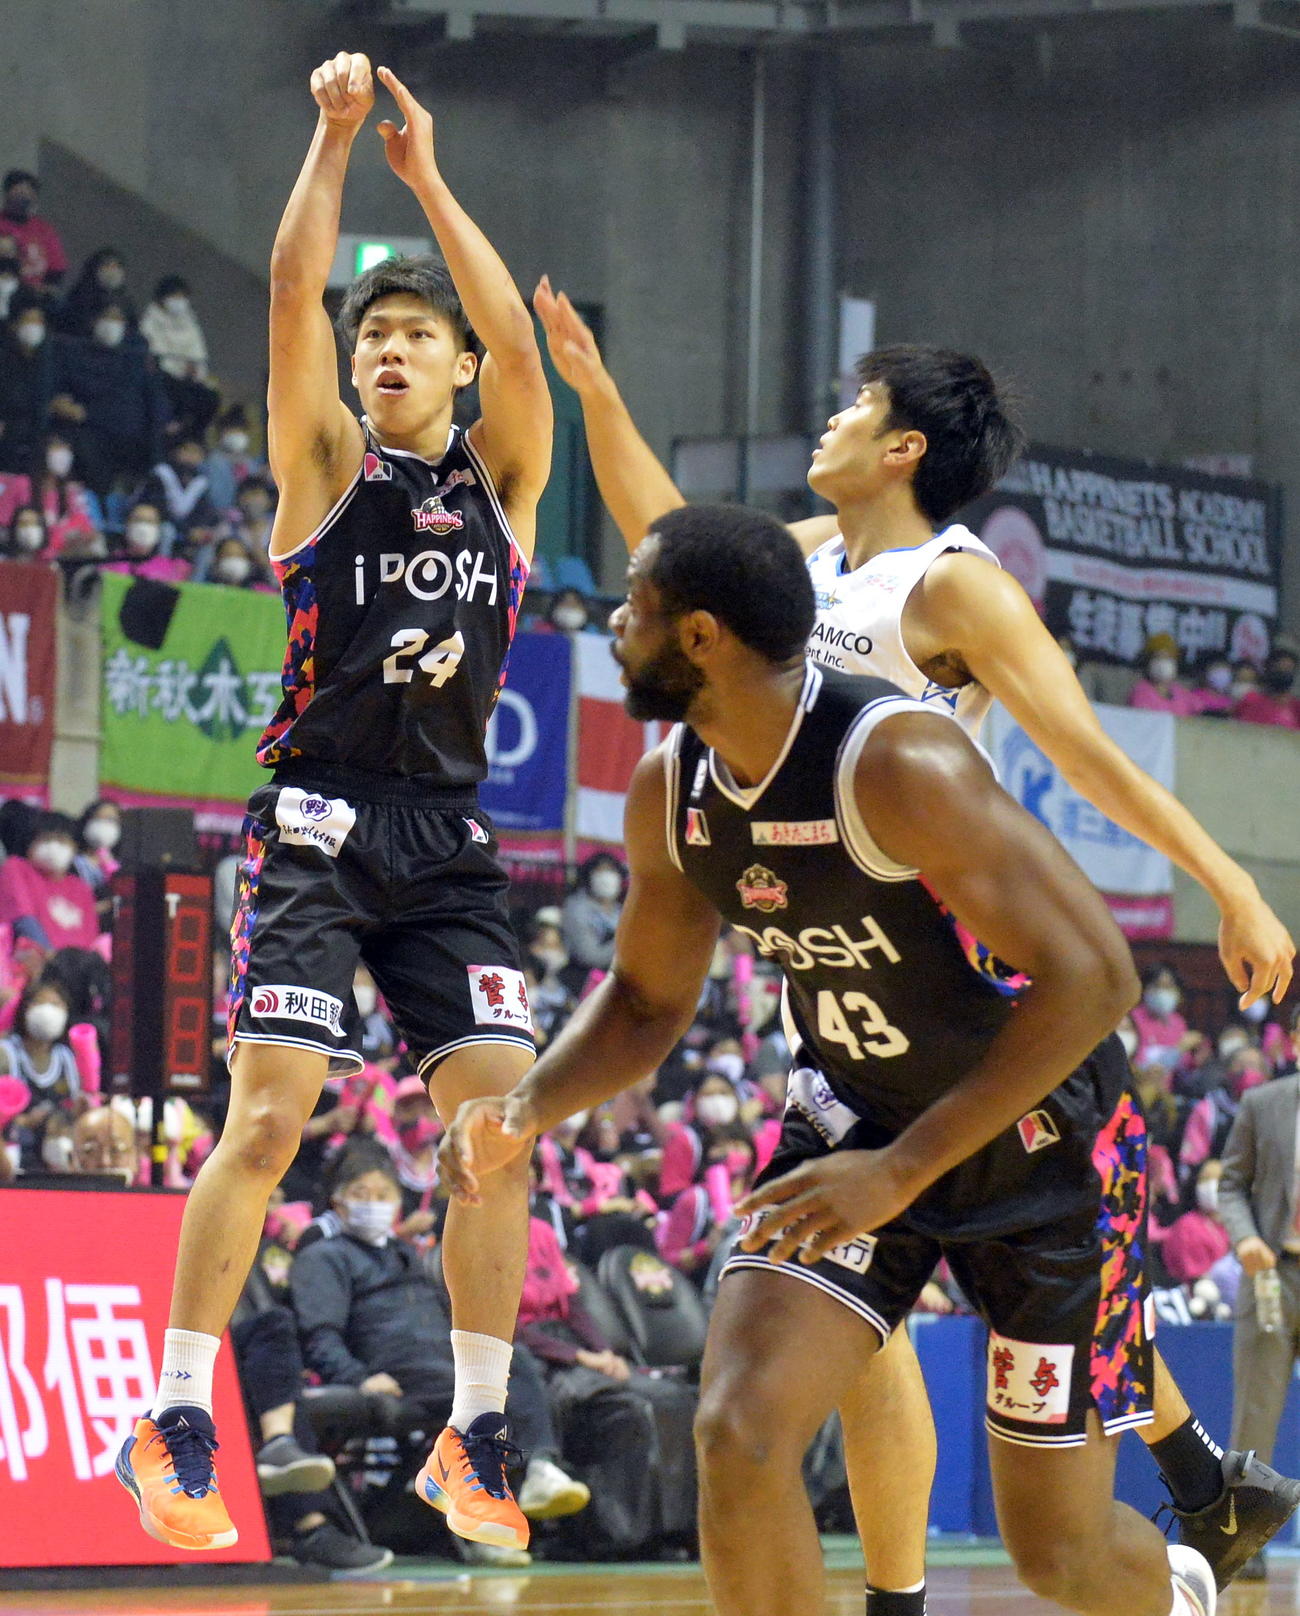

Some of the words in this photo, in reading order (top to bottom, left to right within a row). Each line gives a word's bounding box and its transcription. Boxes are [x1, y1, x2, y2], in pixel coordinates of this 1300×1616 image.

[383, 628, 465, 688] 24
[824, 651, 845, 669] Inc.
[817, 990, 910, 1060] 43
